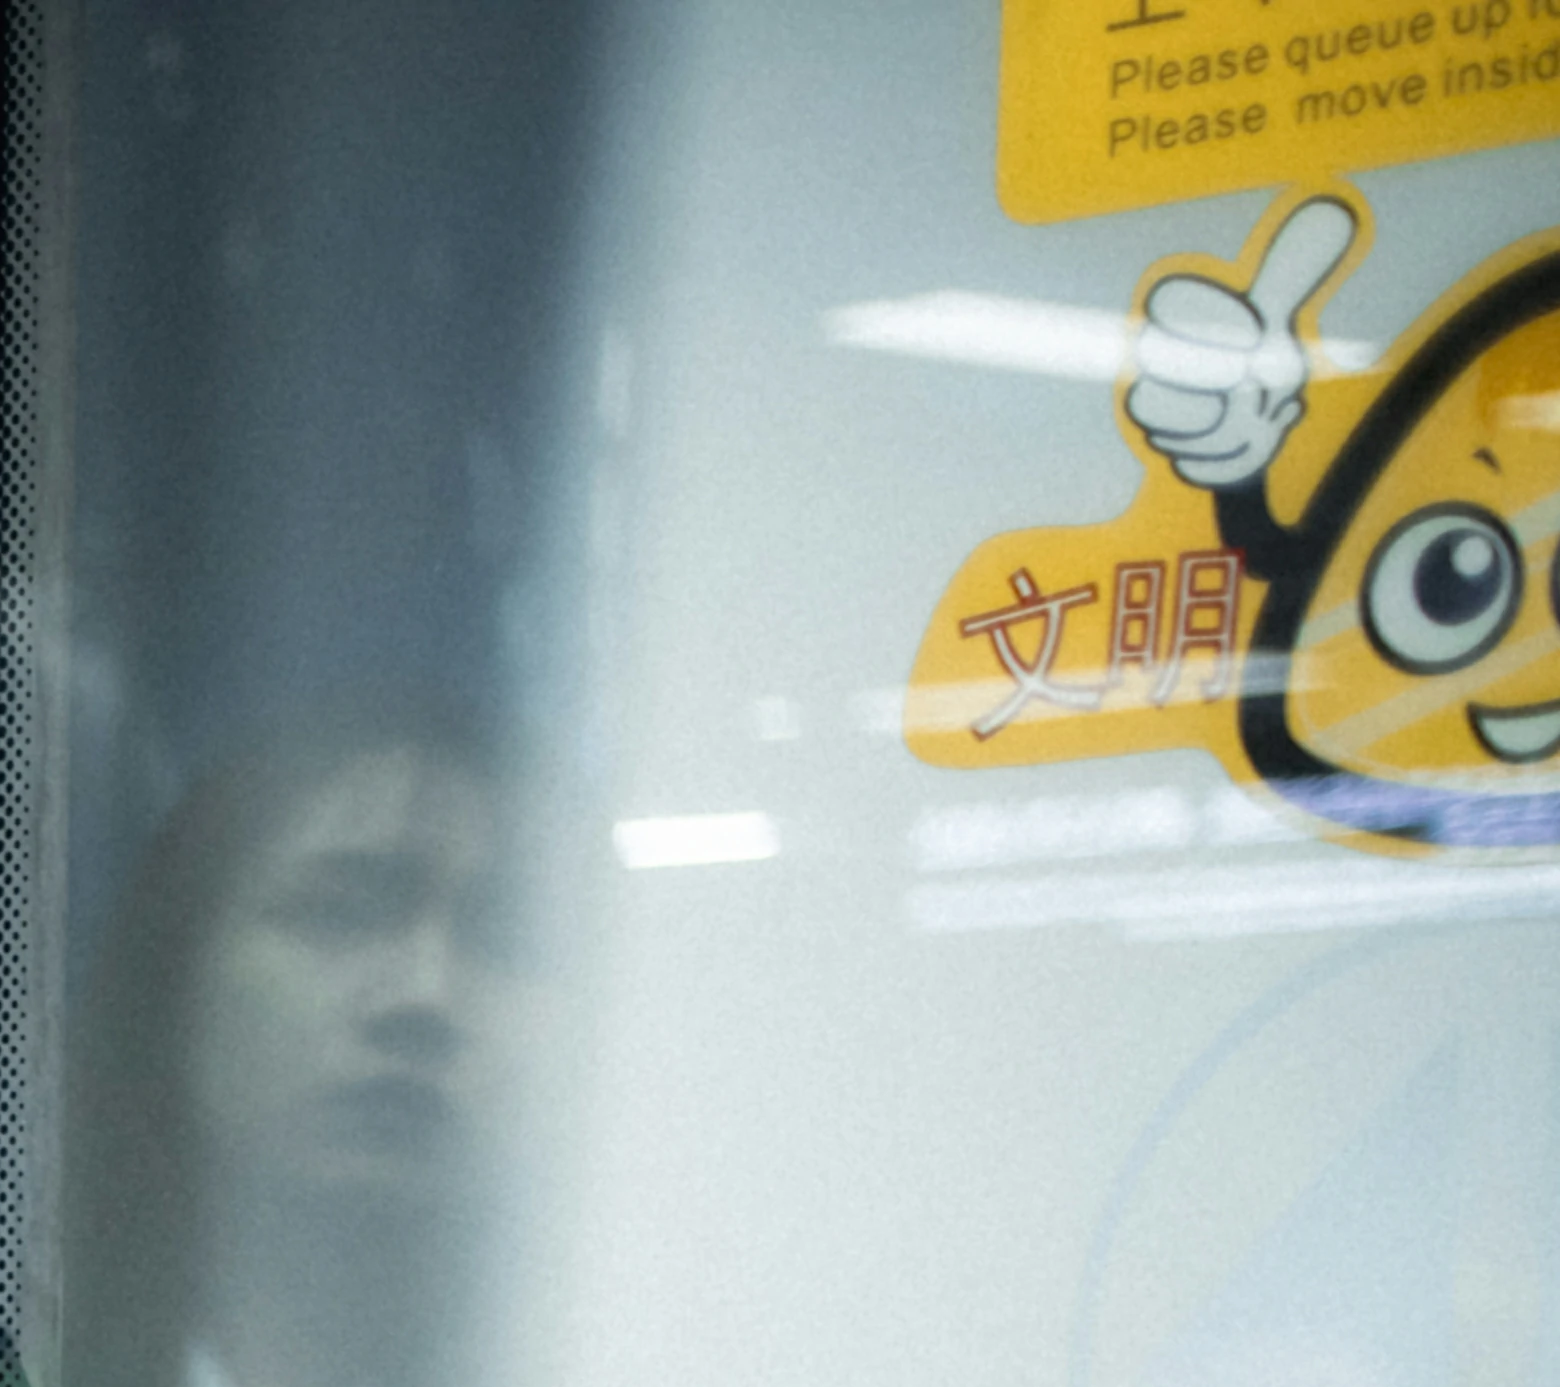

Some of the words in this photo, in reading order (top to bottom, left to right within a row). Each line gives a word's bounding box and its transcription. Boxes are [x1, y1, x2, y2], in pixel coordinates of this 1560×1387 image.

[1110, 43, 1270, 99] Please
[1284, 11, 1436, 76] queue
[1451, 0, 1513, 40] up
[1108, 102, 1268, 158] Please
[1295, 73, 1428, 125] move
[960, 546, 1246, 742] 文明
